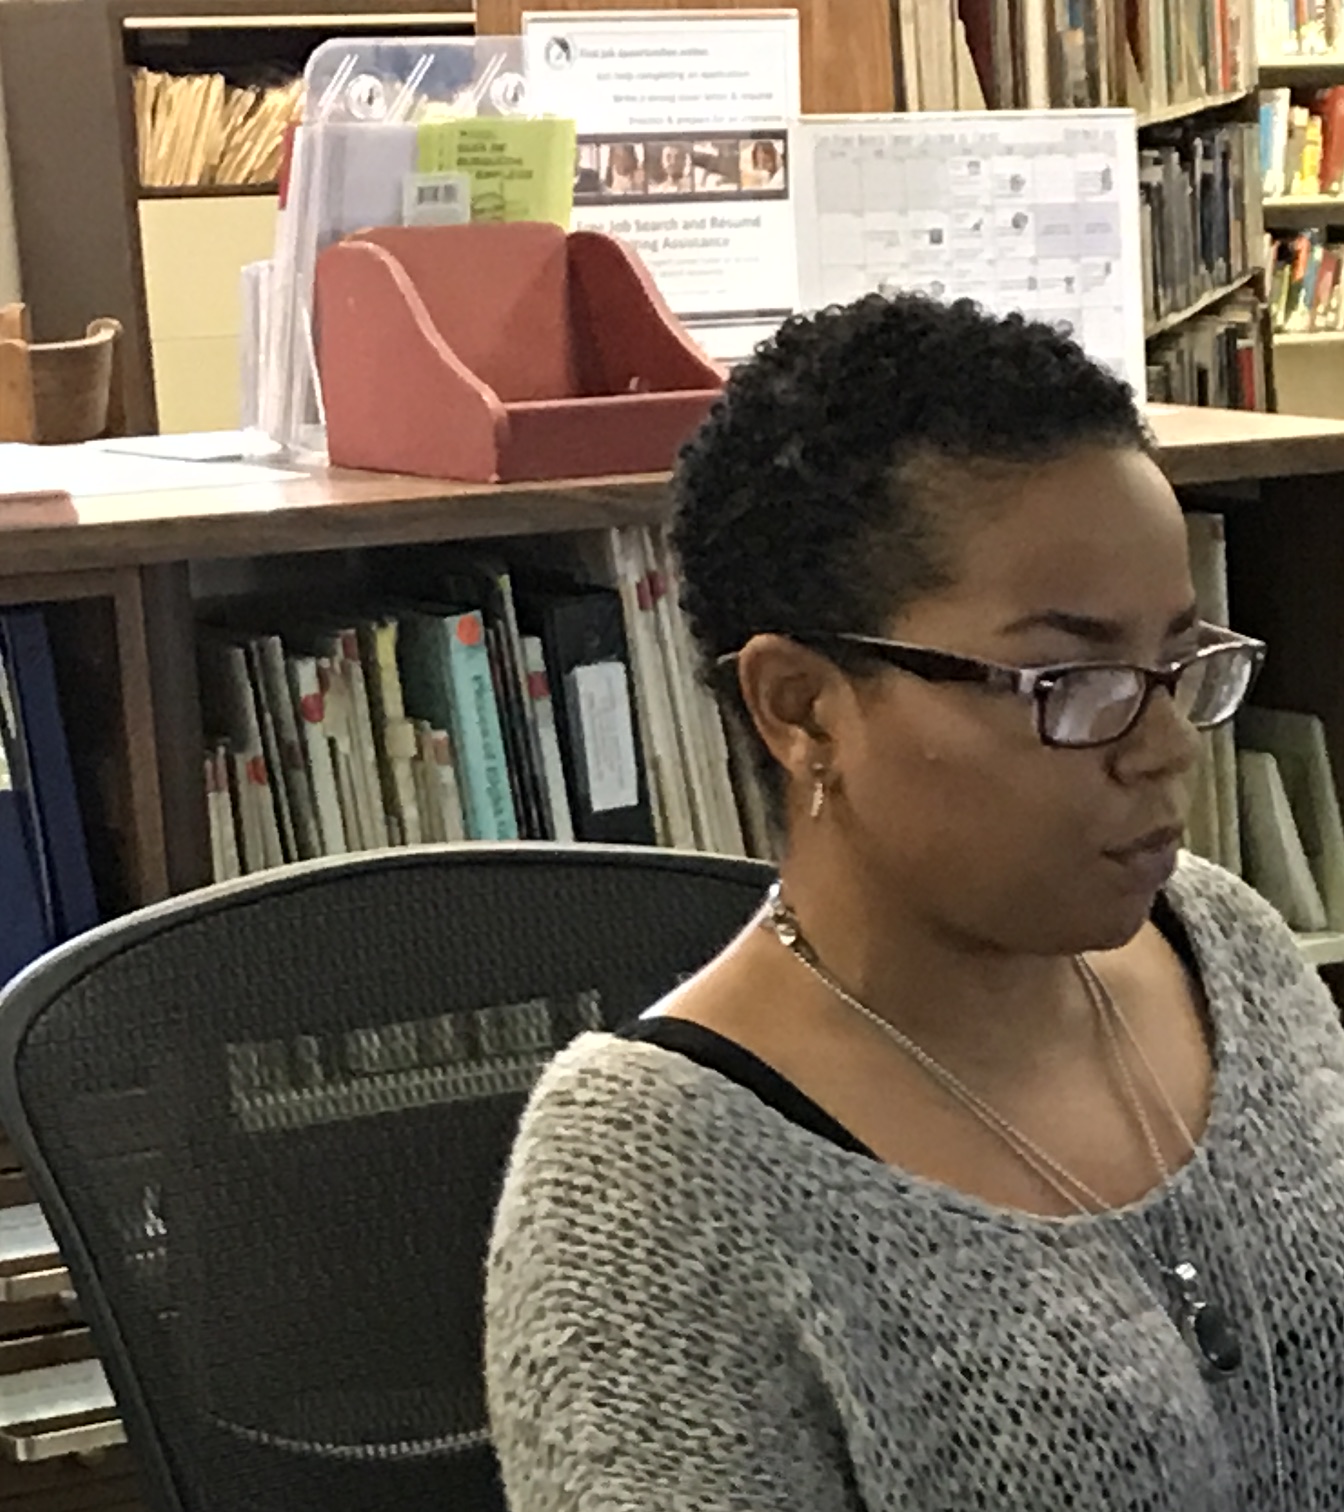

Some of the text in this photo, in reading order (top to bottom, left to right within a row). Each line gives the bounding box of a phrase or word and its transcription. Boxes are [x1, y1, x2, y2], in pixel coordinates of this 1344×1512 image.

[609, 219, 632, 233] Job
[635, 217, 679, 231] Search
[682, 217, 707, 230] and
[662, 236, 731, 250] Assistance
